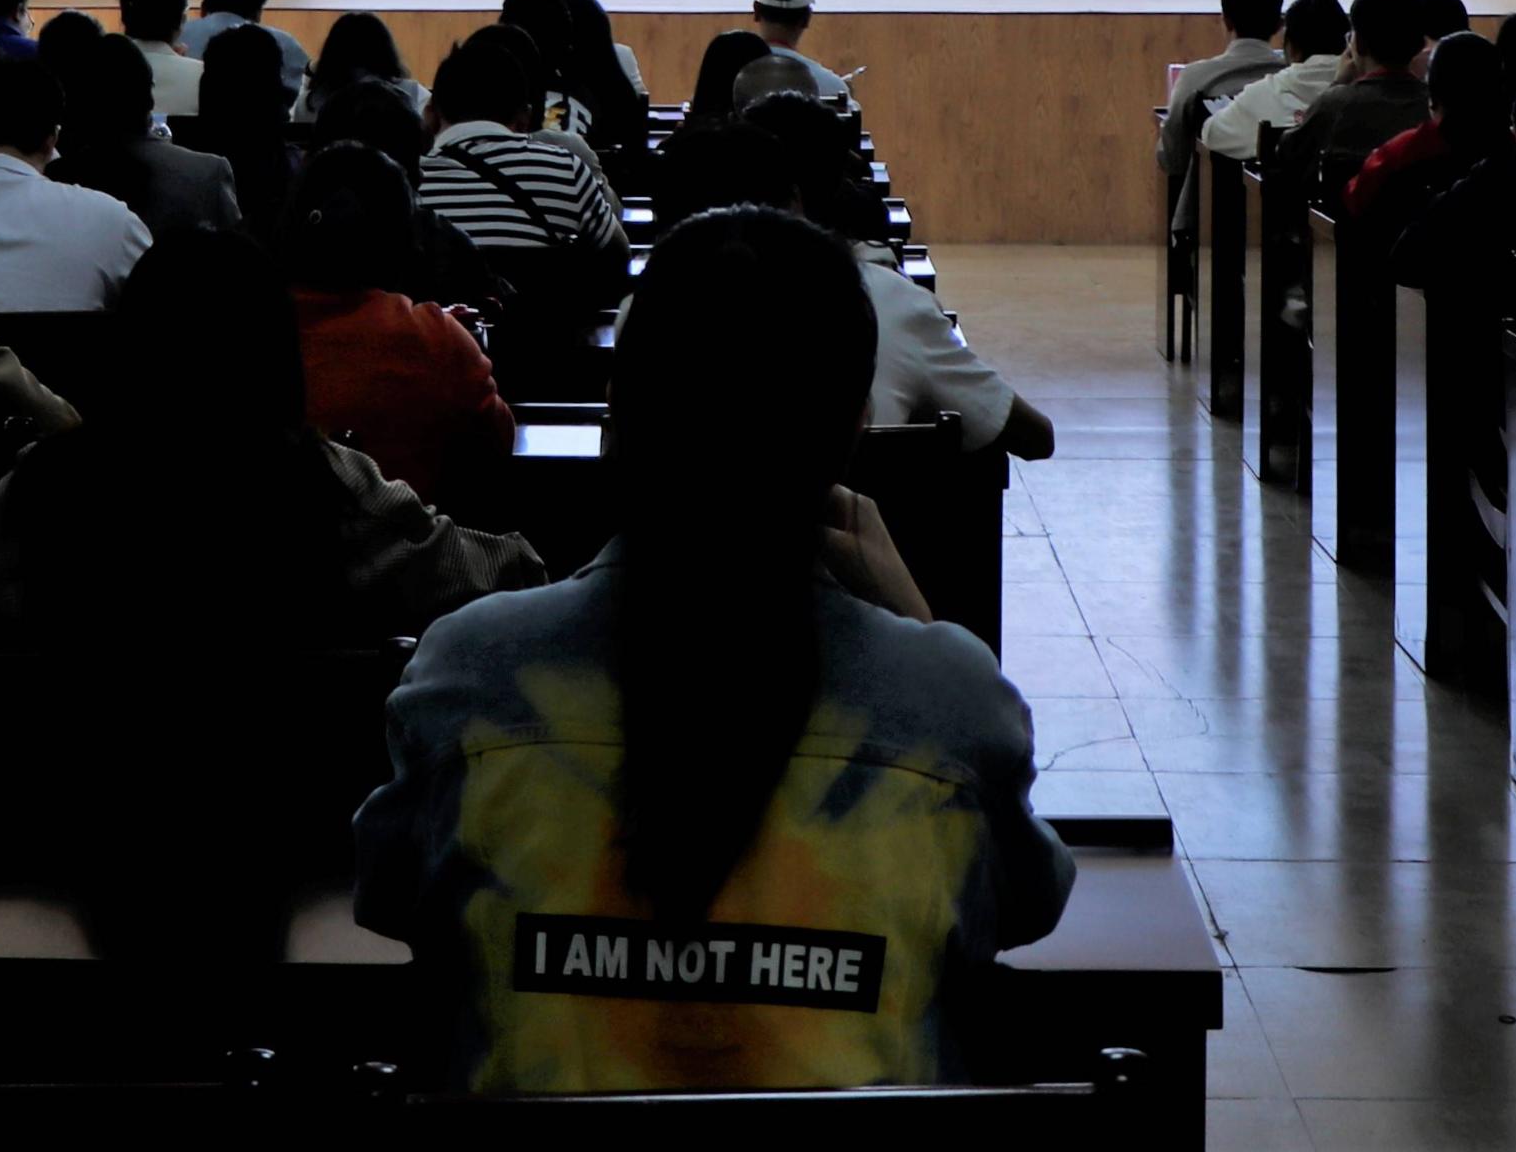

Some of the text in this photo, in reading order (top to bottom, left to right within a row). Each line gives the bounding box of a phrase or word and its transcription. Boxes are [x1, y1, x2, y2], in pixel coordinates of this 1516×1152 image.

[535, 931, 863, 993] I AM NOT HERE
